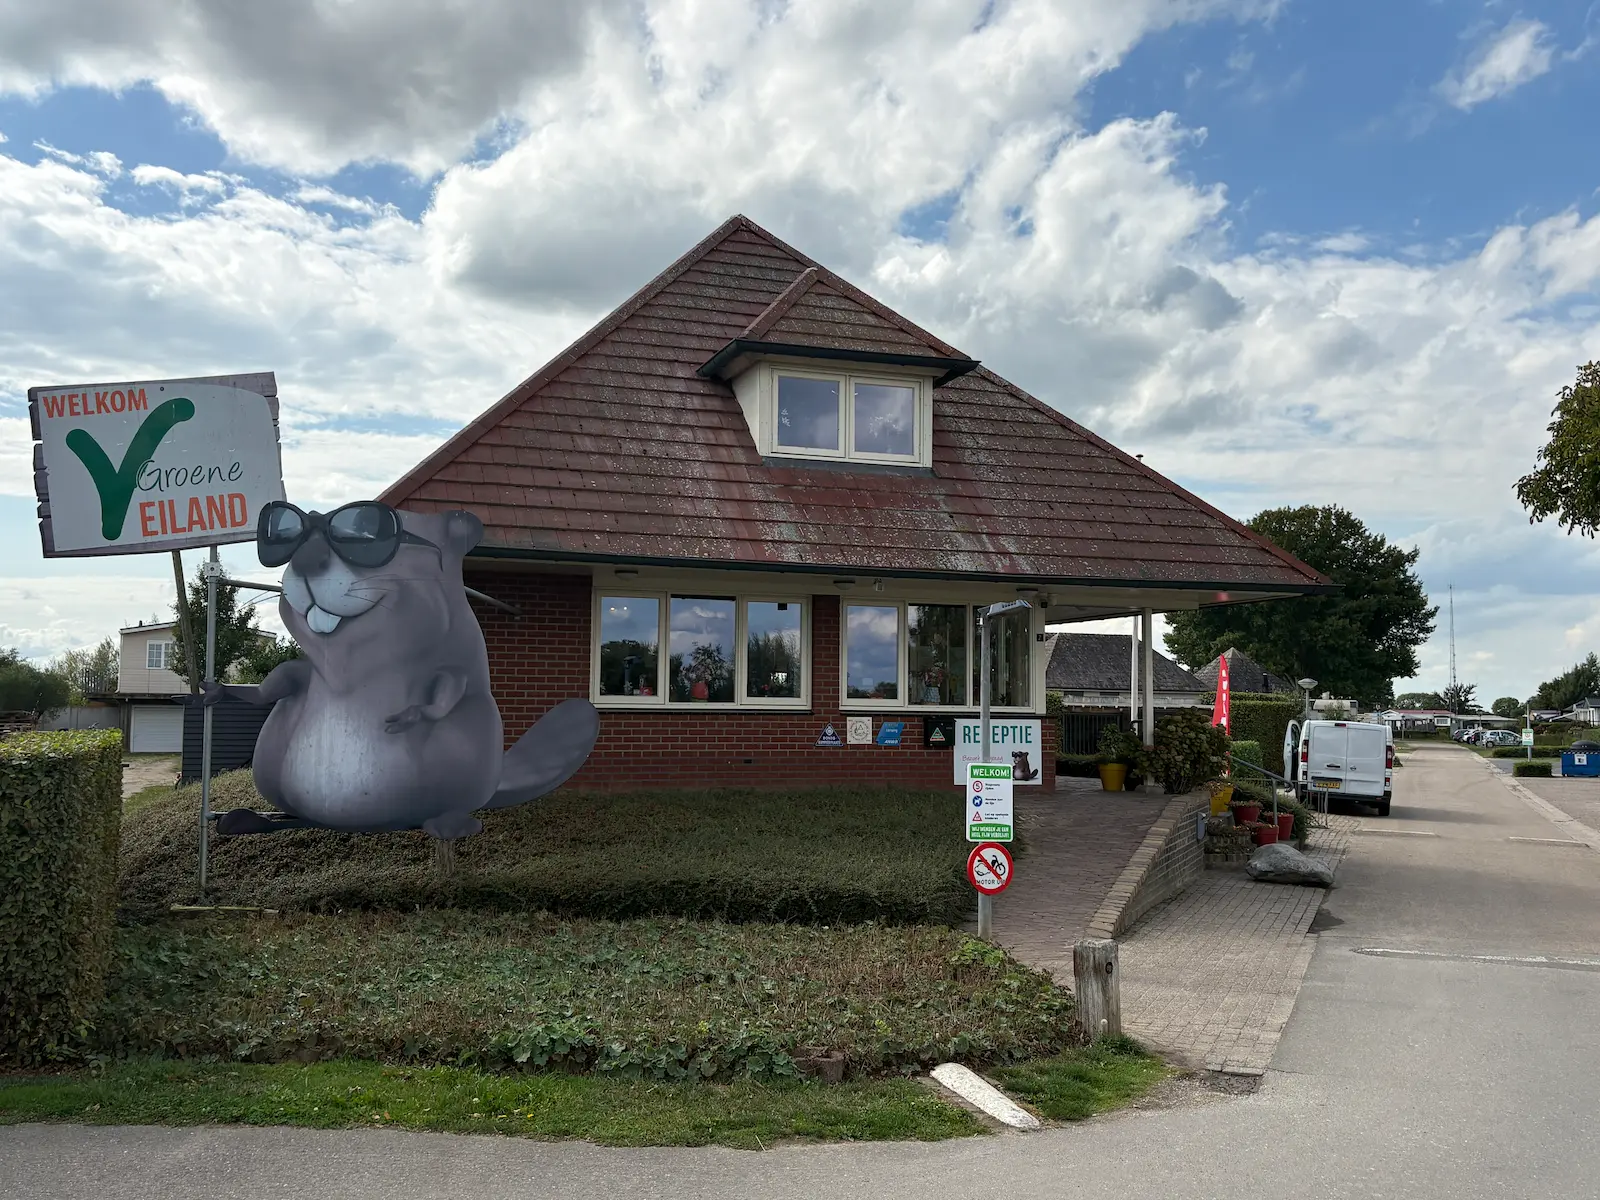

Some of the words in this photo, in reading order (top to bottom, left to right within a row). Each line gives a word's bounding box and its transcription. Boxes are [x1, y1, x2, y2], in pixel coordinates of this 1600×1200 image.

[42, 388, 149, 419] WELKOM
[137, 459, 243, 492] Groene
[139, 492, 249, 537] EILAND
[962, 725, 1033, 744] REEPTIE
[973, 767, 1010, 777] WELKOM!
